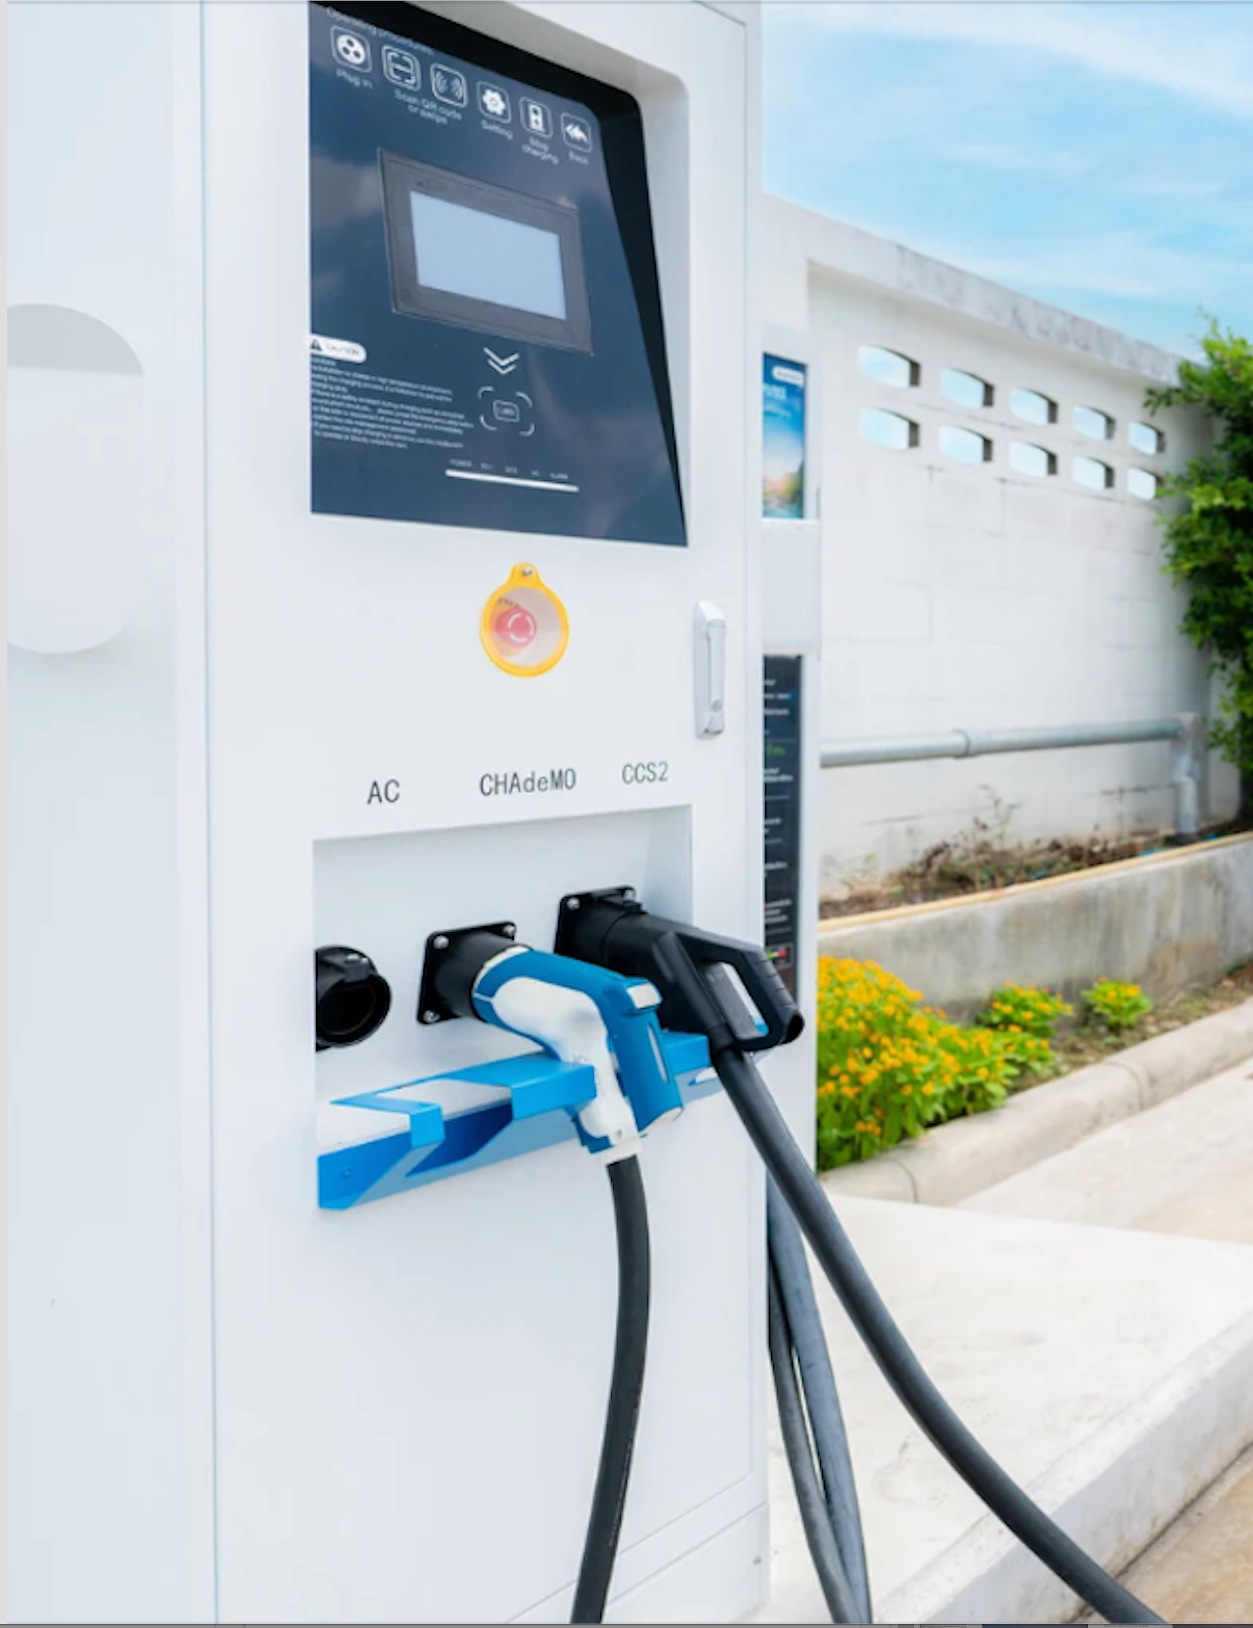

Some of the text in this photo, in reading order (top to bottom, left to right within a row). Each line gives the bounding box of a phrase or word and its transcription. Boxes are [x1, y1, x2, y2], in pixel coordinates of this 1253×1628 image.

[336, 68, 373, 89] Plug in
[367, 761, 669, 804] AC CHAdeMO CCS2
